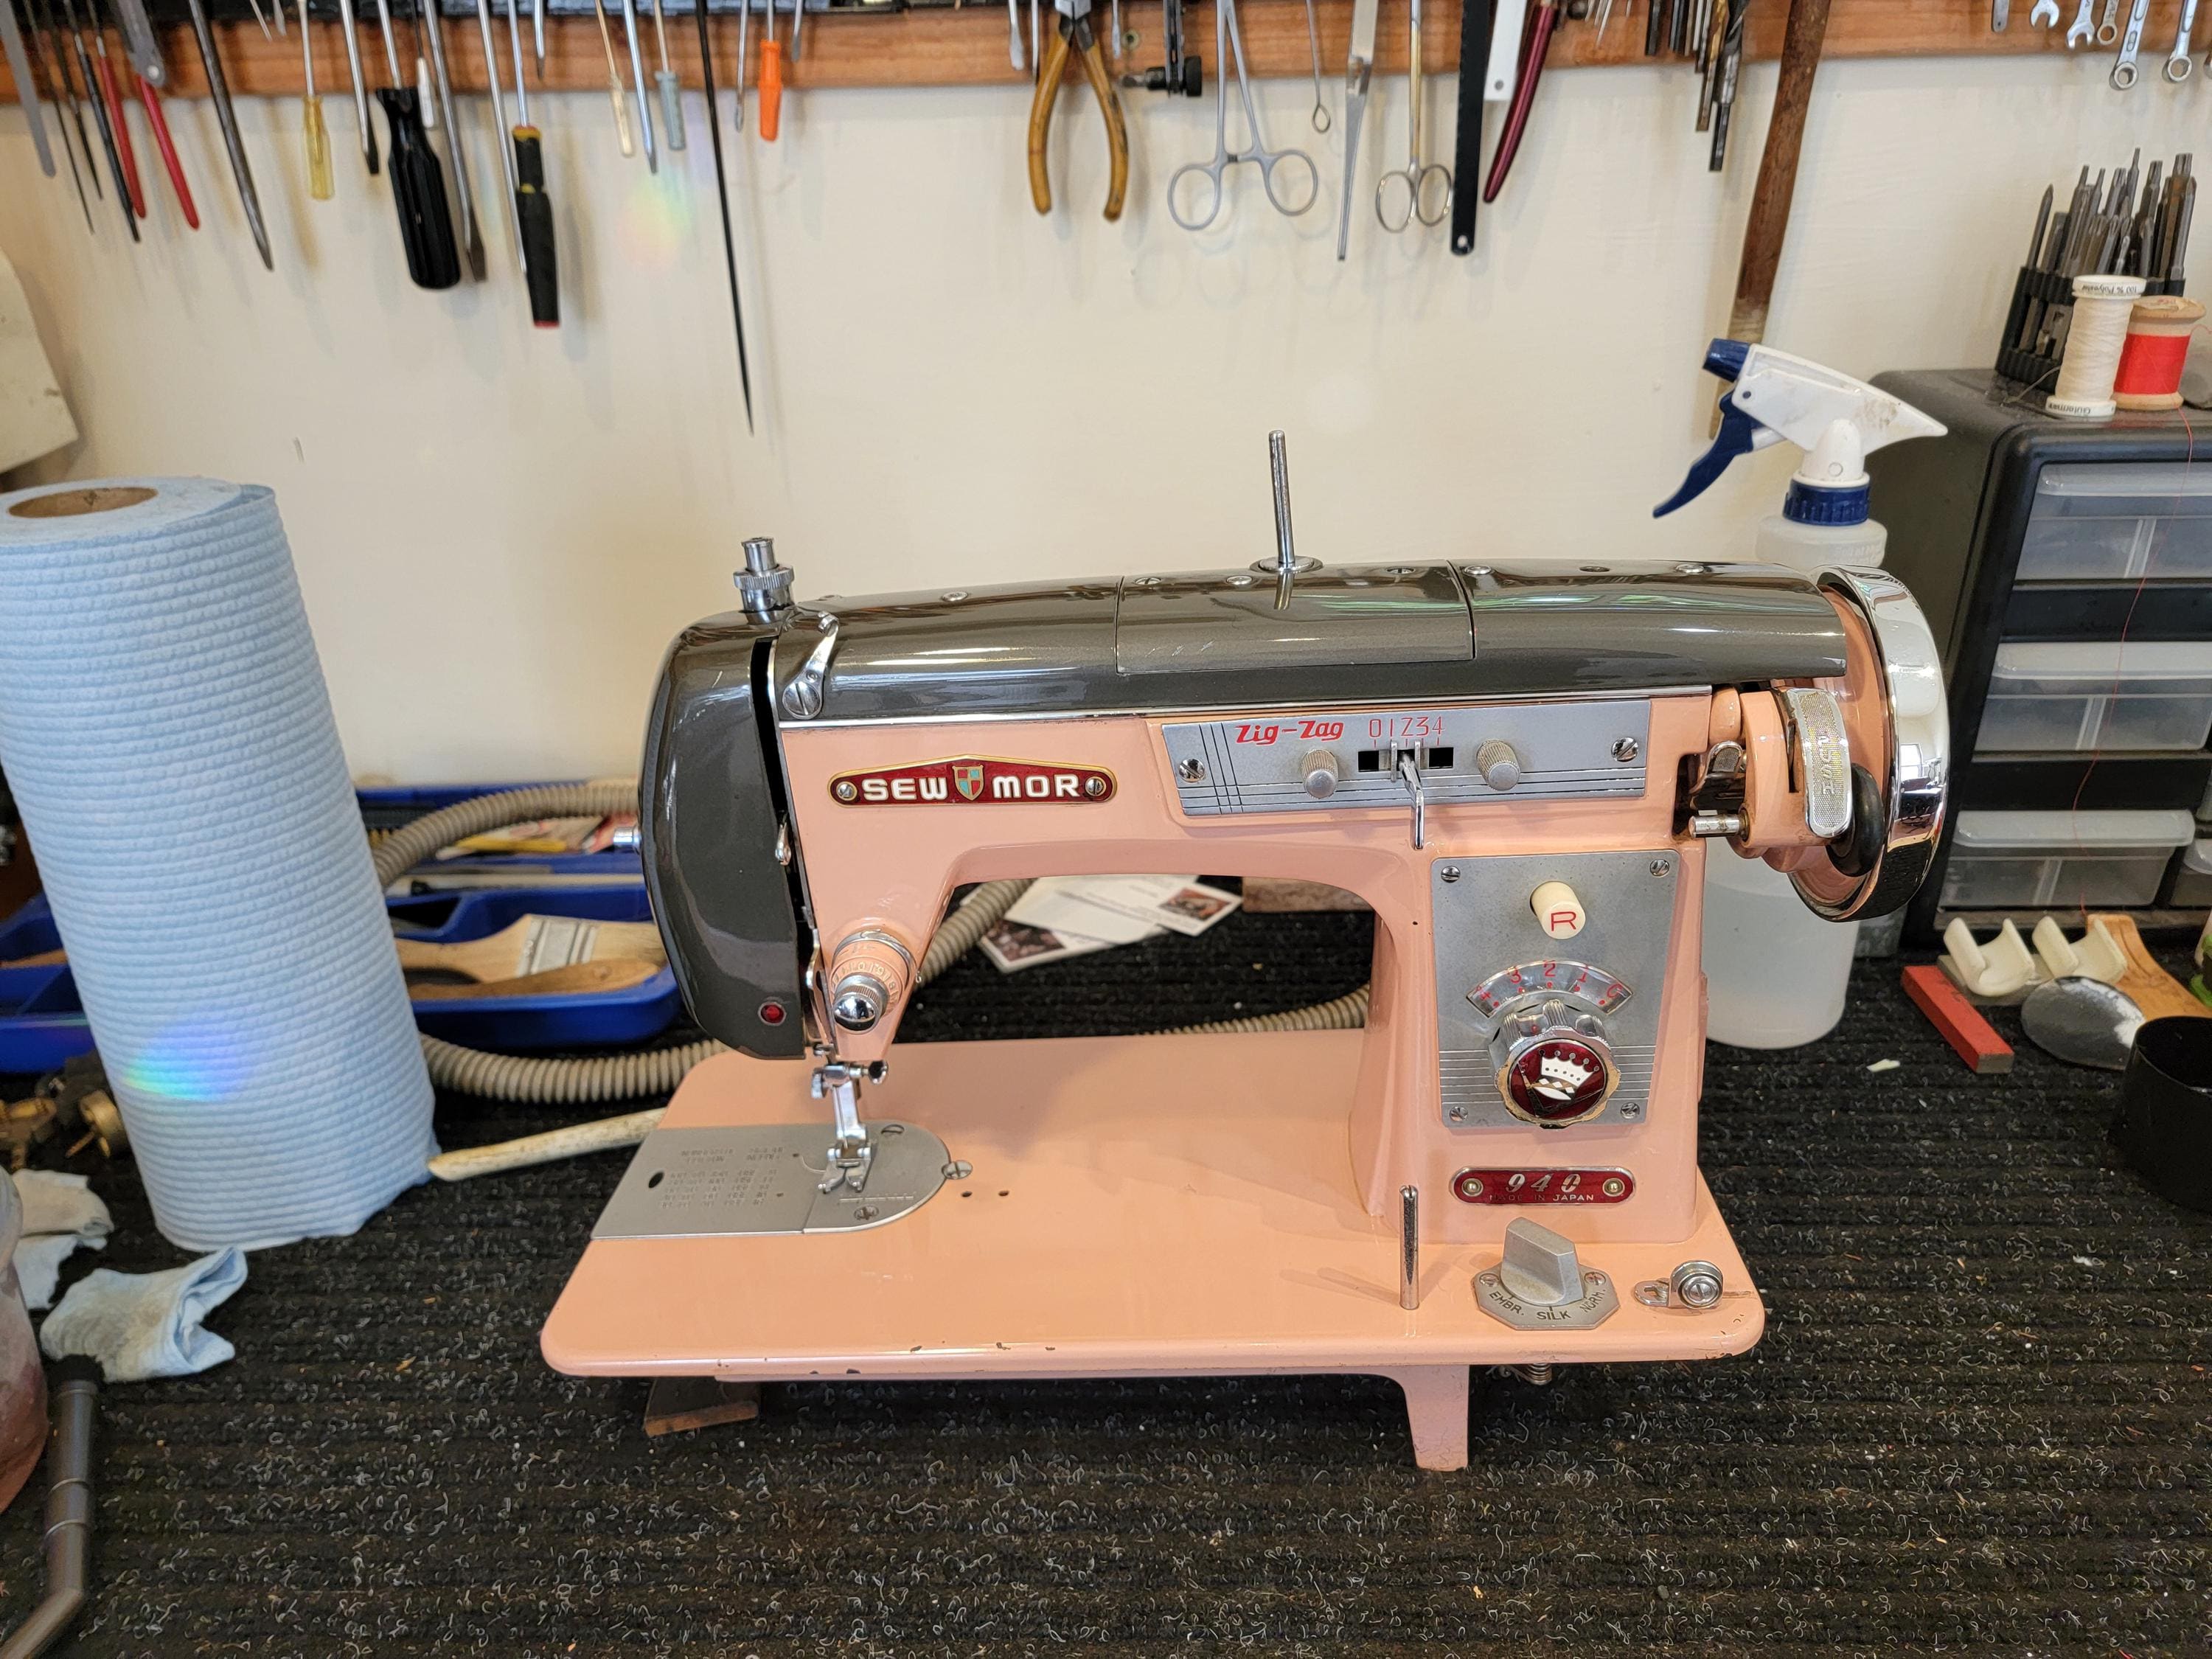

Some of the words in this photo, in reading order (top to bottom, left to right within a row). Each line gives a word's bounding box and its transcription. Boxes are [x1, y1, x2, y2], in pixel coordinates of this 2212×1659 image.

[1235, 720, 1344, 745] Zig-Zag
[862, 776, 948, 801] SEW
[992, 773, 1082, 799] MOR
[1551, 911, 1576, 931] R
[1508, 965, 1522, 984] 3
[1543, 960, 1556, 977] 2
[1489, 1290, 1525, 1316] EMBR.
[1579, 1289, 1606, 1313] NORM.
[1536, 1310, 1571, 1321] SILK
